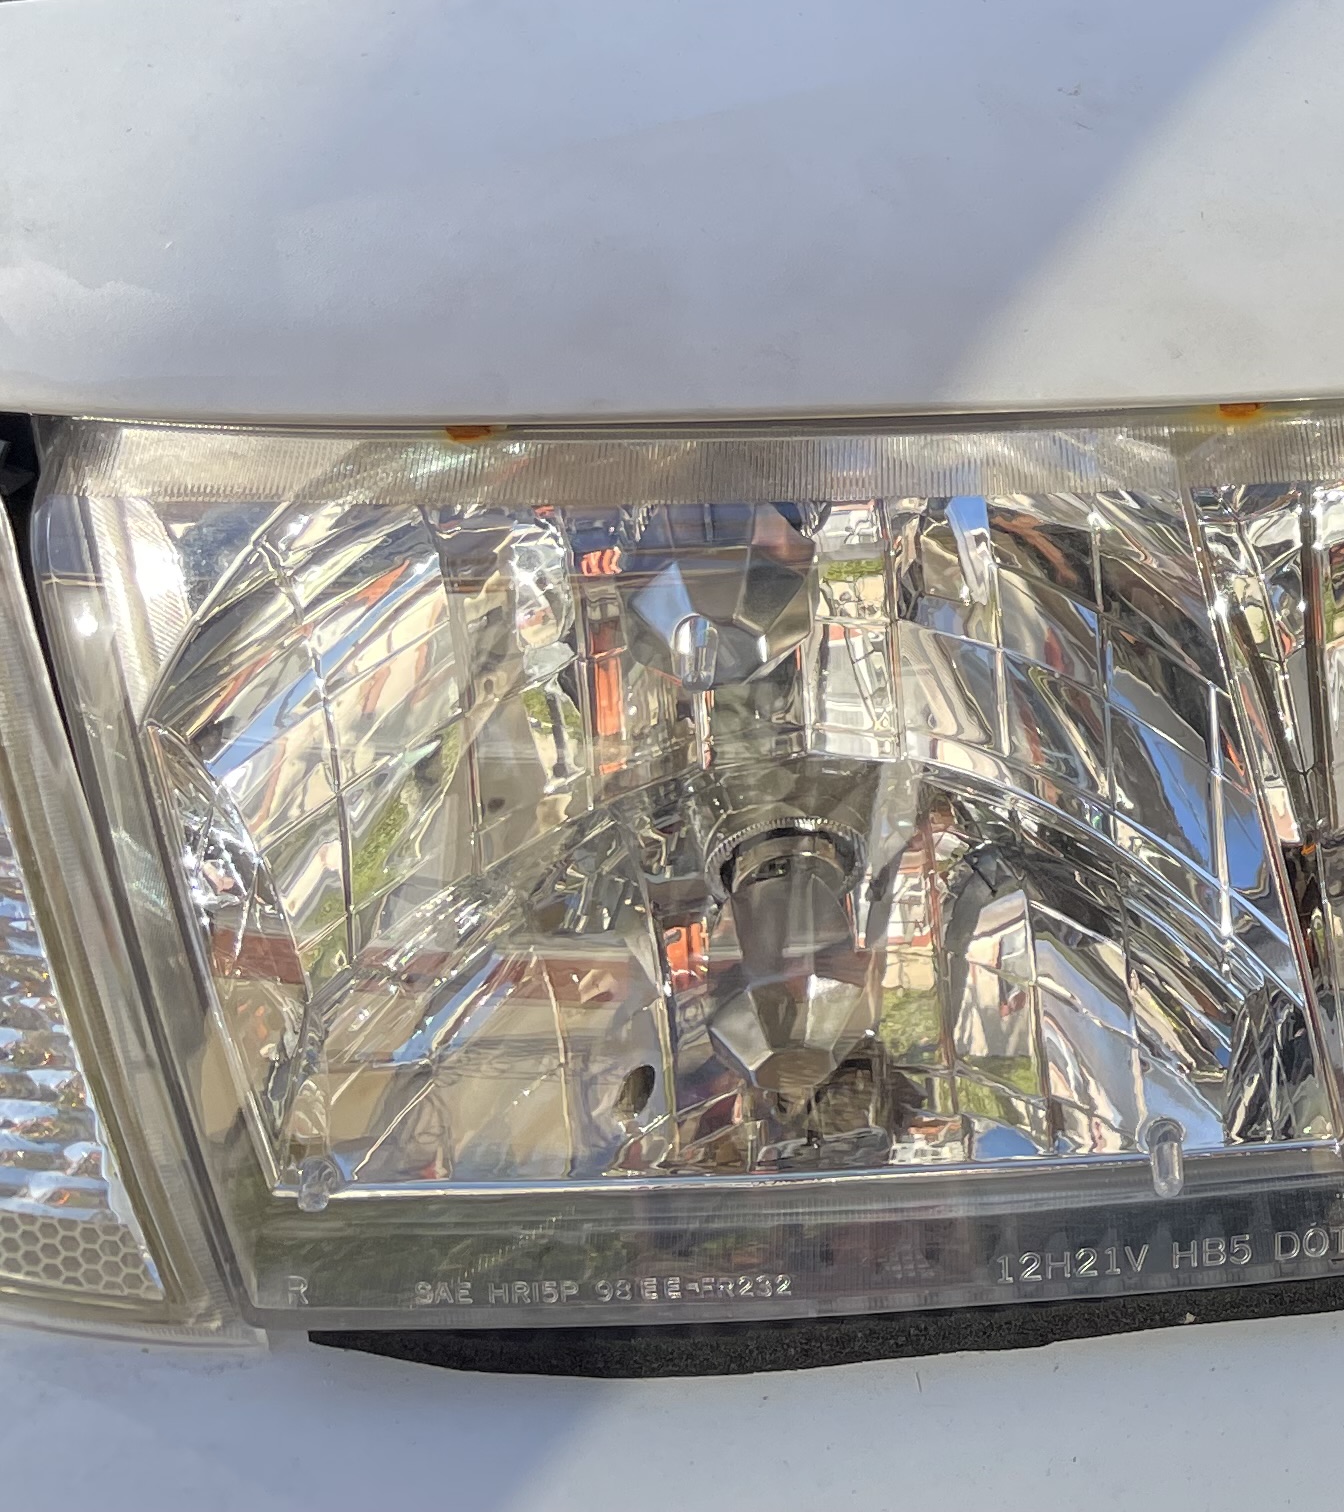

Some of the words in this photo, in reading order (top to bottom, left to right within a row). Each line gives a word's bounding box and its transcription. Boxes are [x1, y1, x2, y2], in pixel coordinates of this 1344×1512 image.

[995, 1243, 1150, 1284] 12H21V
[1171, 1233, 1253, 1270] HB5
[286, 1275, 310, 1306] R
[414, 1281, 474, 1305] SAE
